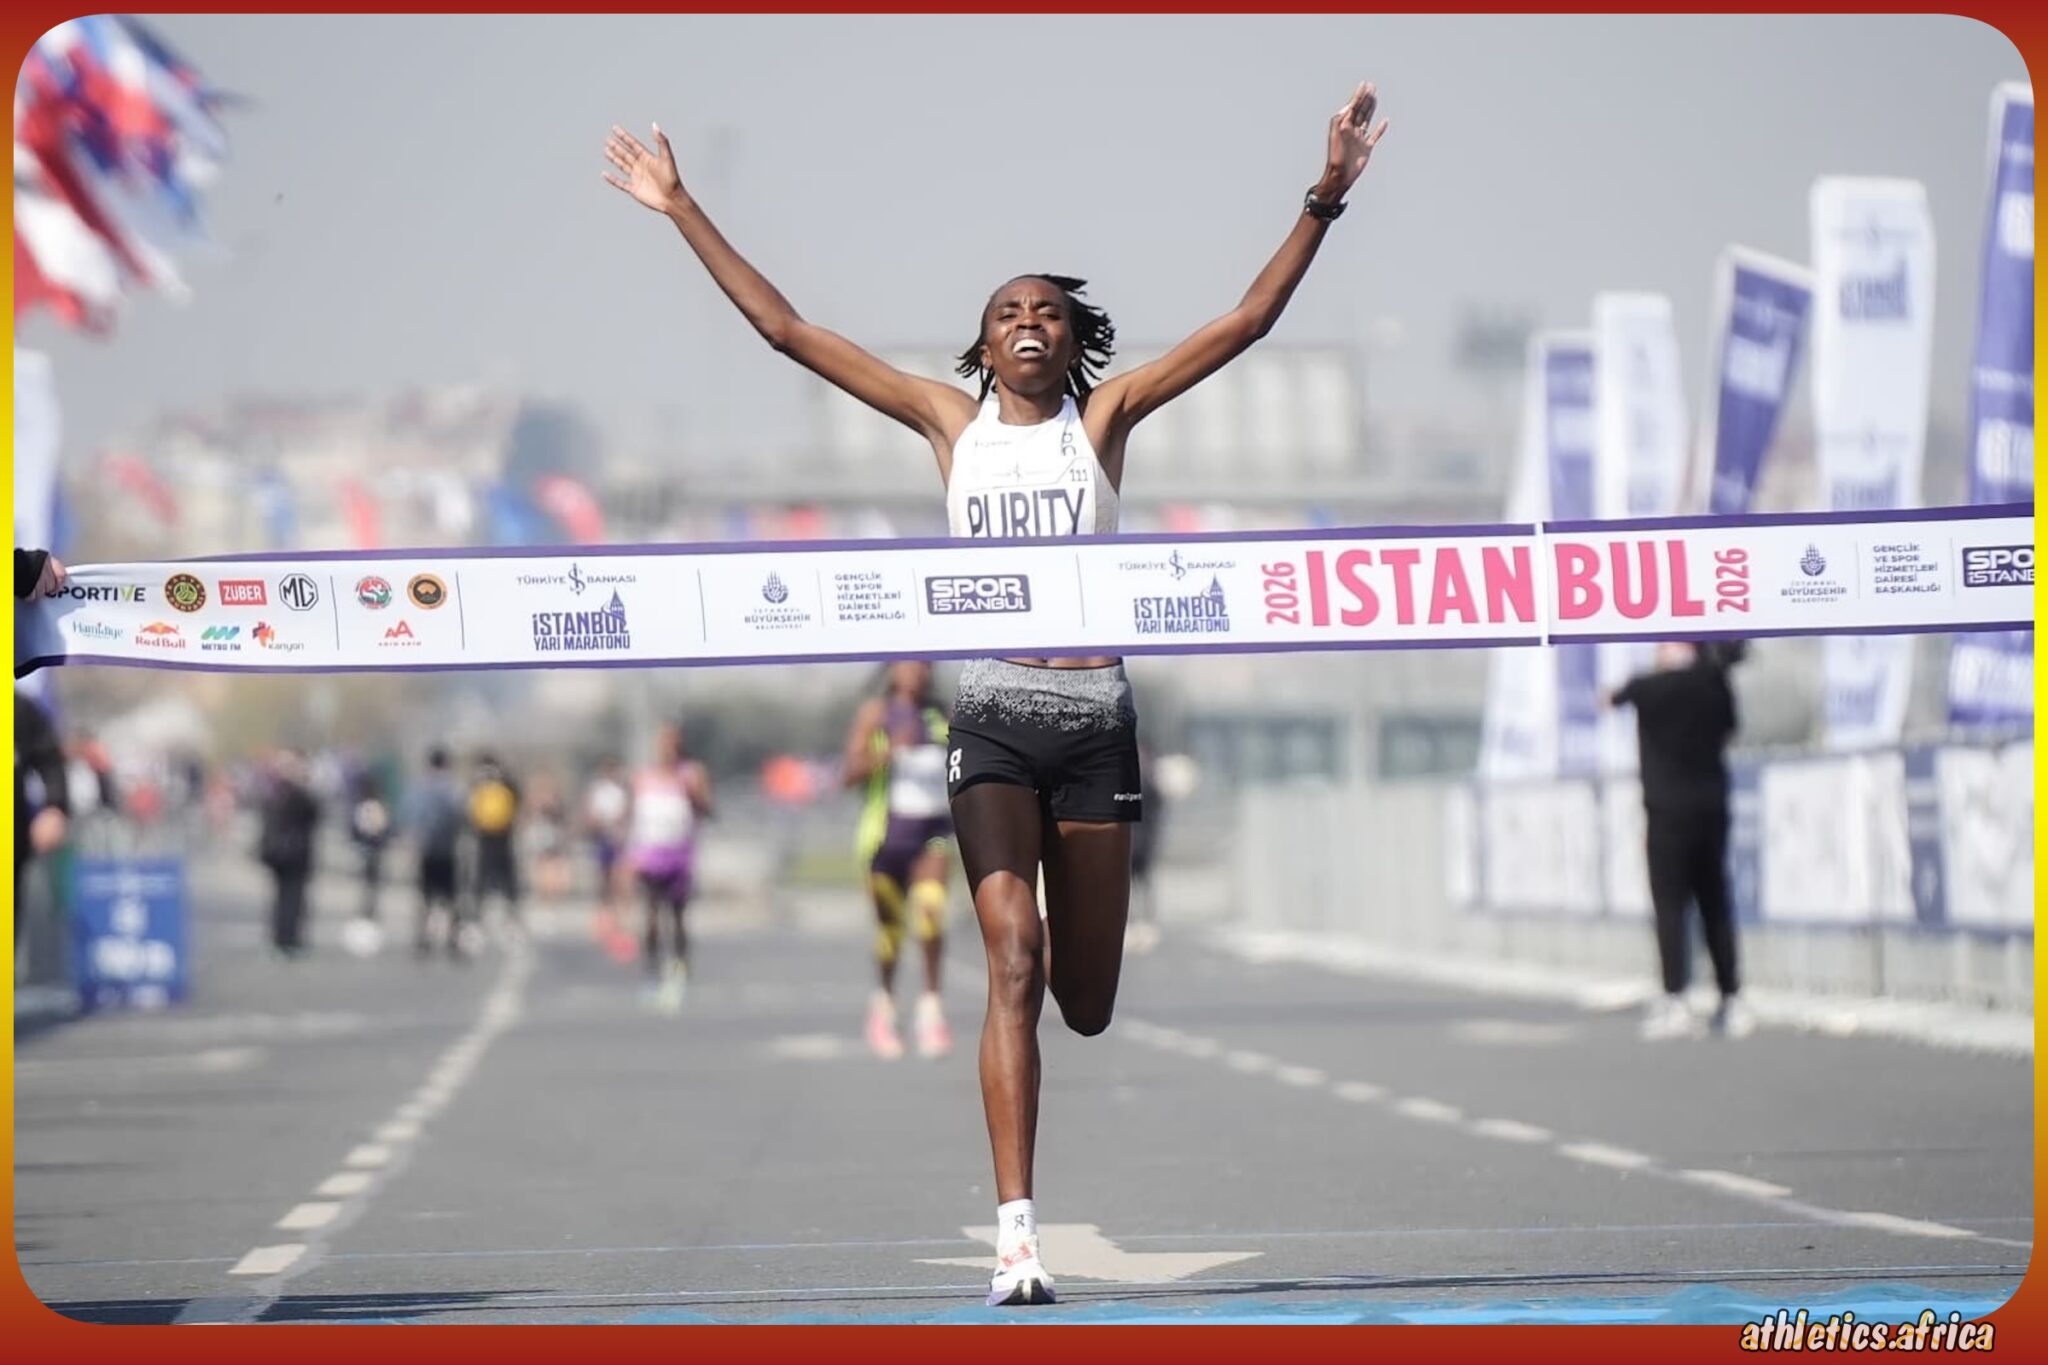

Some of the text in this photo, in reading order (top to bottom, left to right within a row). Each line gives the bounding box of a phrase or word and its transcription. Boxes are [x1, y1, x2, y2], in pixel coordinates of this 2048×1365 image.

[967, 487, 1086, 538] PURITY
[587, 574, 636, 584] BANKASI
[931, 577, 1024, 599] SPOR
[1714, 548, 1751, 613] 2026
[283, 577, 315, 608] MG
[1261, 561, 1300, 625] 2026
[1135, 618, 1231, 634] YARI MARATONU
[135, 636, 186, 649] Red Bull
[201, 643, 242, 652] METRO FM
[534, 634, 631, 651] YARI MARATONU
